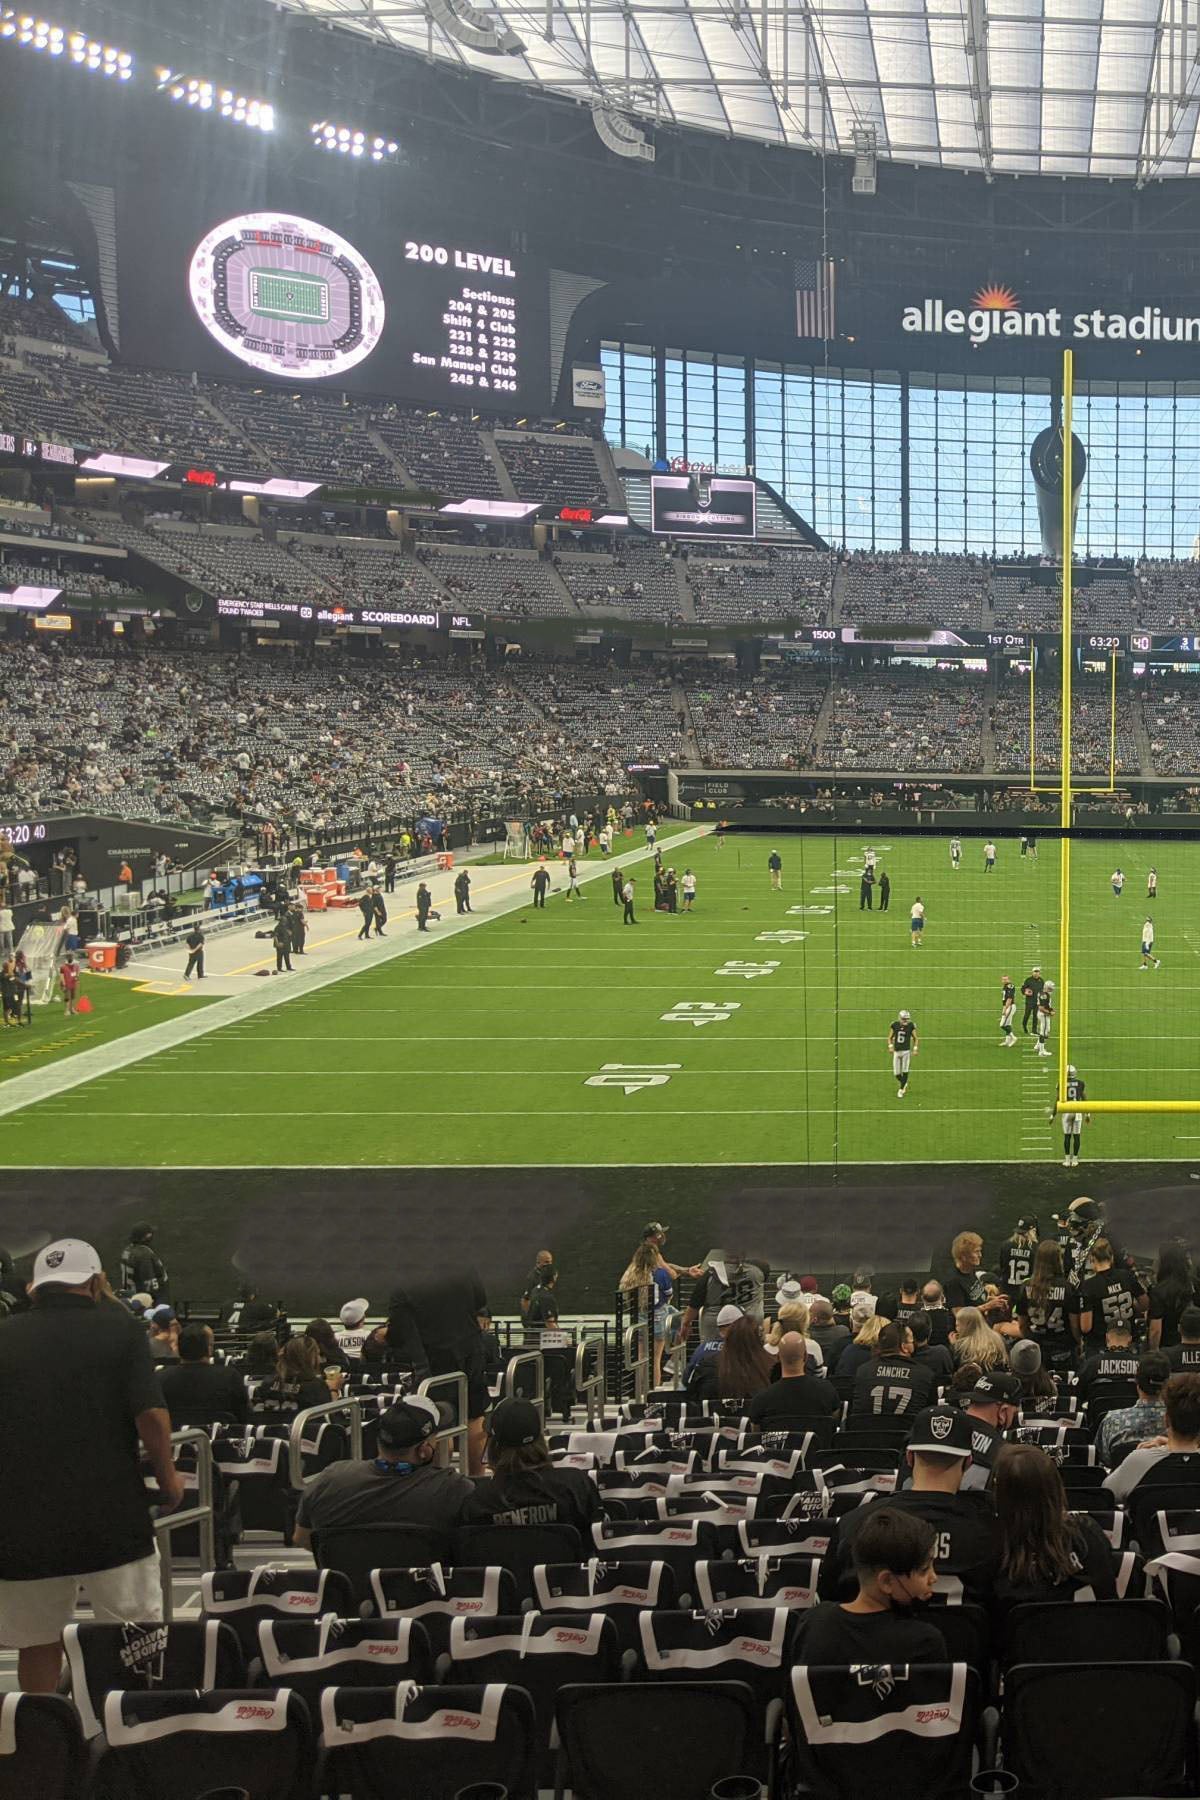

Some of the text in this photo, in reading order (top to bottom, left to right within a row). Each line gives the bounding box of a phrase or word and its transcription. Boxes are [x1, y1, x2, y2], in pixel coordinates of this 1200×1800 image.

[404, 241, 516, 277] 200 LEVEL
[462, 287, 515, 306] Sections:
[449, 300, 516, 320] 204 & 205
[443, 313, 516, 334] Shift 4 Club
[902, 299, 1061, 342] allegiant
[449, 329, 516, 349] 221 & 222
[450, 343, 516, 363] 228 & 229
[412, 352, 517, 377] San Manuel Club
[450, 372, 517, 392] 245 & 246
[670, 456, 713, 473] Coors
[317, 611, 435, 625] allegiant SCOREBOARD
[452, 617, 471, 627] NFL
[812, 630, 836, 640] 1500
[1090, 637, 1120, 647] 63:20
[1133, 638, 1149, 650] 40
[33, 825, 46, 839] 40
[93, 949, 104, 963] G
[897, 1031, 905, 1044] 6
[1008, 1259, 1030, 1285] 12
[1107, 1283, 1122, 1294] MACK
[1102, 1291, 1134, 1322] 52
[877, 1366, 910, 1379] SANCHEZ
[1098, 1360, 1139, 1375] JACKSON
[870, 1385, 913, 1415] 17
[120, 1624, 169, 1658] NATION
[122, 1638, 168, 1667] RAIDER
[915, 1707, 950, 1723] Coca-Cola
